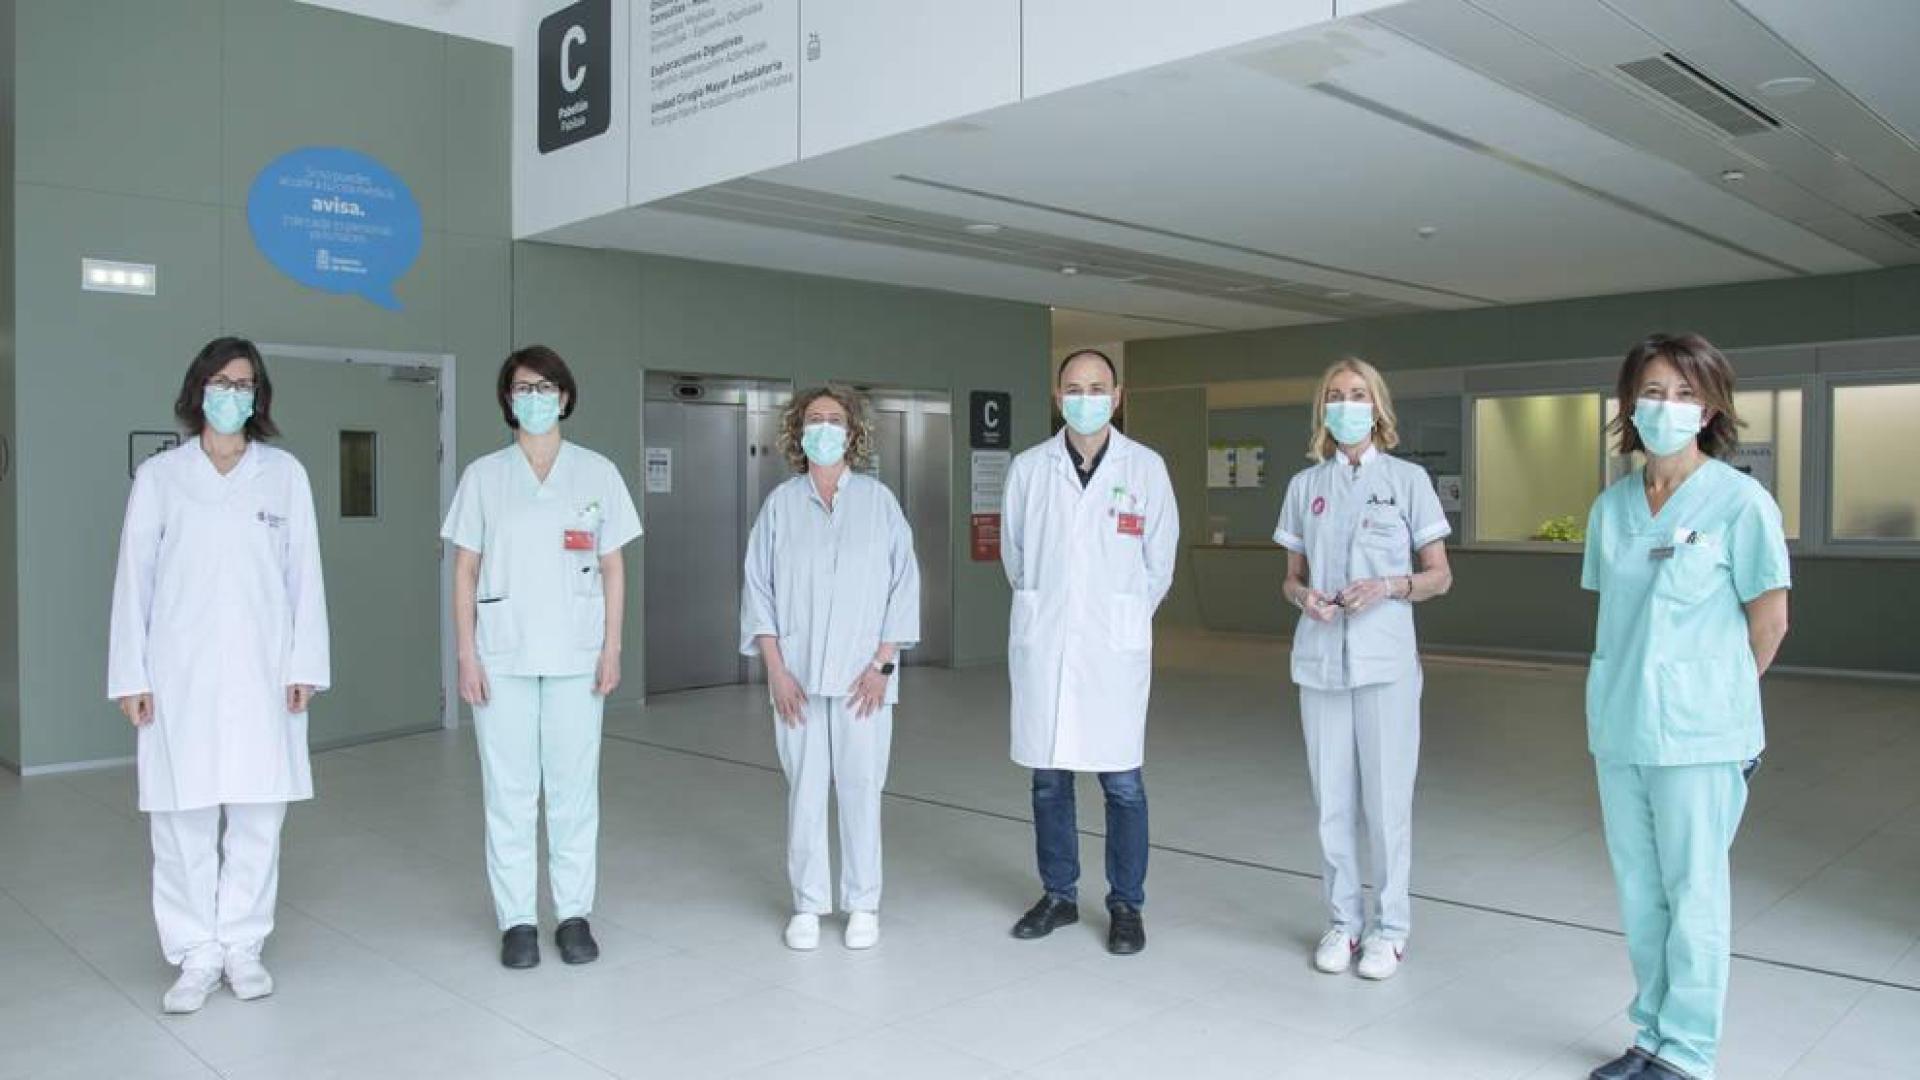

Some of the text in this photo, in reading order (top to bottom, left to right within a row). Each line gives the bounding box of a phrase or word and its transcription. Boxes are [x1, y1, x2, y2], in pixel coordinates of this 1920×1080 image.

[560, 24, 587, 92] C
[312, 196, 366, 217] avisa.
[984, 400, 999, 428] C
